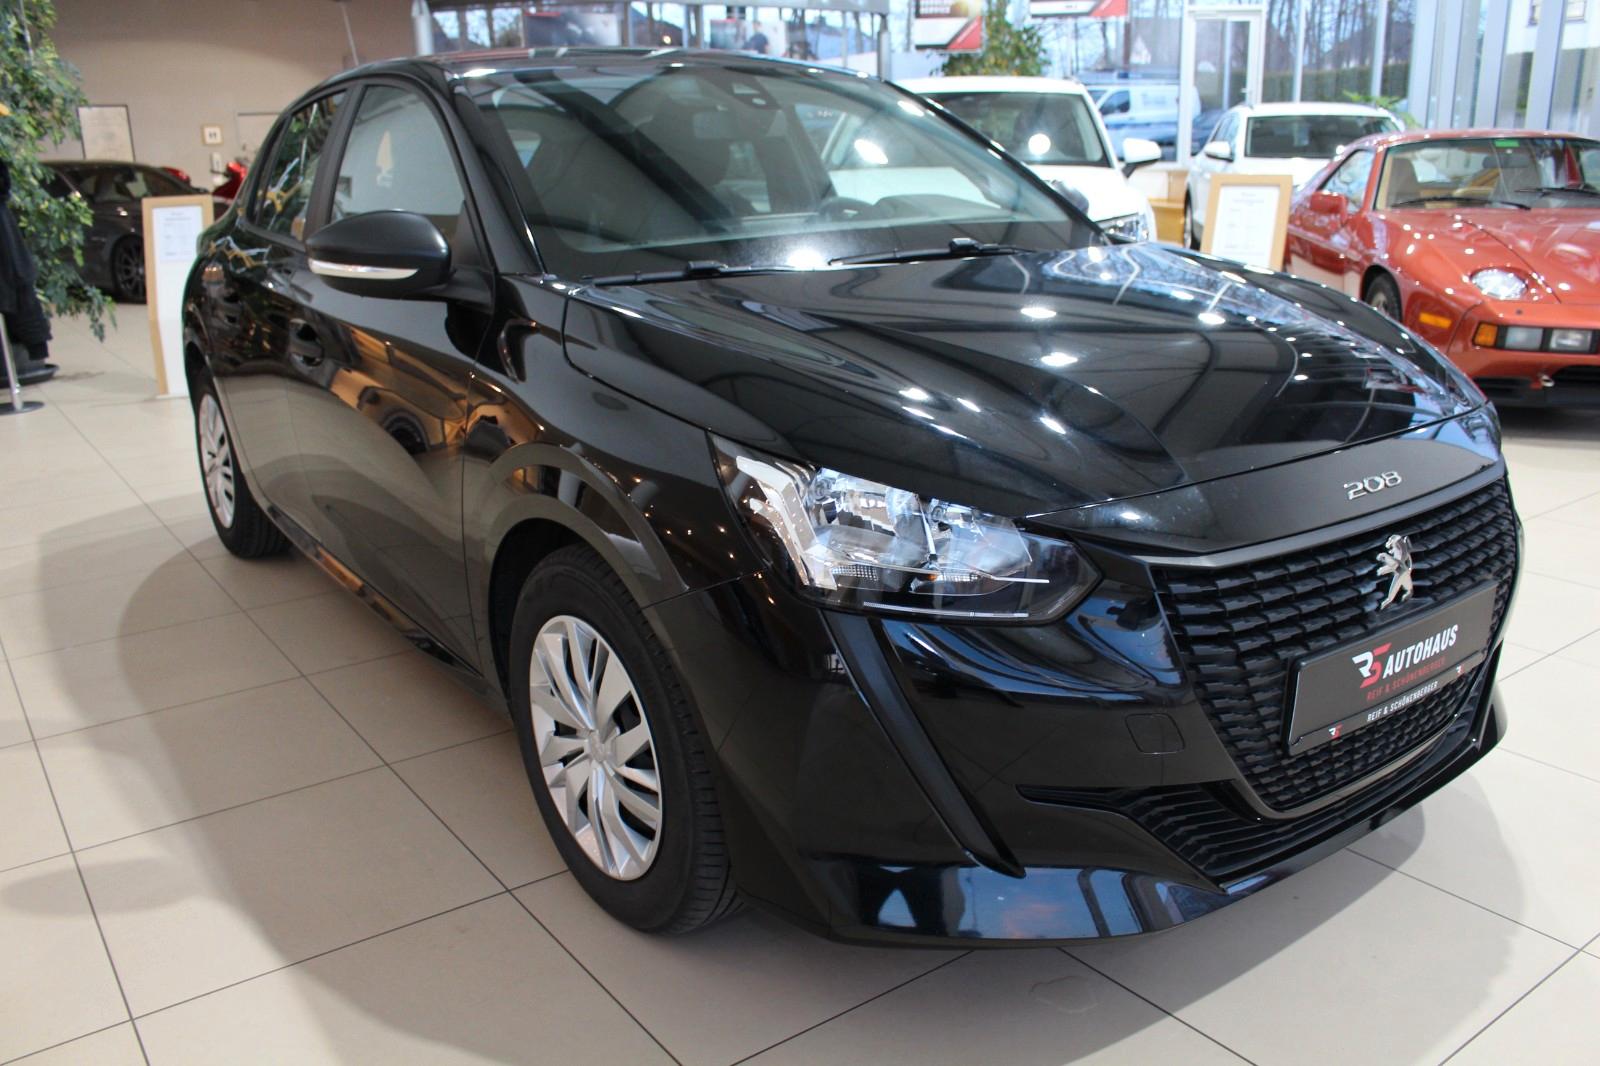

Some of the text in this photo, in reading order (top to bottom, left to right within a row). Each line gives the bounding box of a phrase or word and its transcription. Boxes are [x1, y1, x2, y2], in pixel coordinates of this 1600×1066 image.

[1343, 471, 1402, 500] 208
[1382, 624, 1459, 680] AUTOHAUS
[1366, 657, 1445, 700] REIF & SCHÖNENBERGER
[1367, 710, 1382, 722] REIF
[1389, 681, 1439, 712] SCHÖNENBERGER
